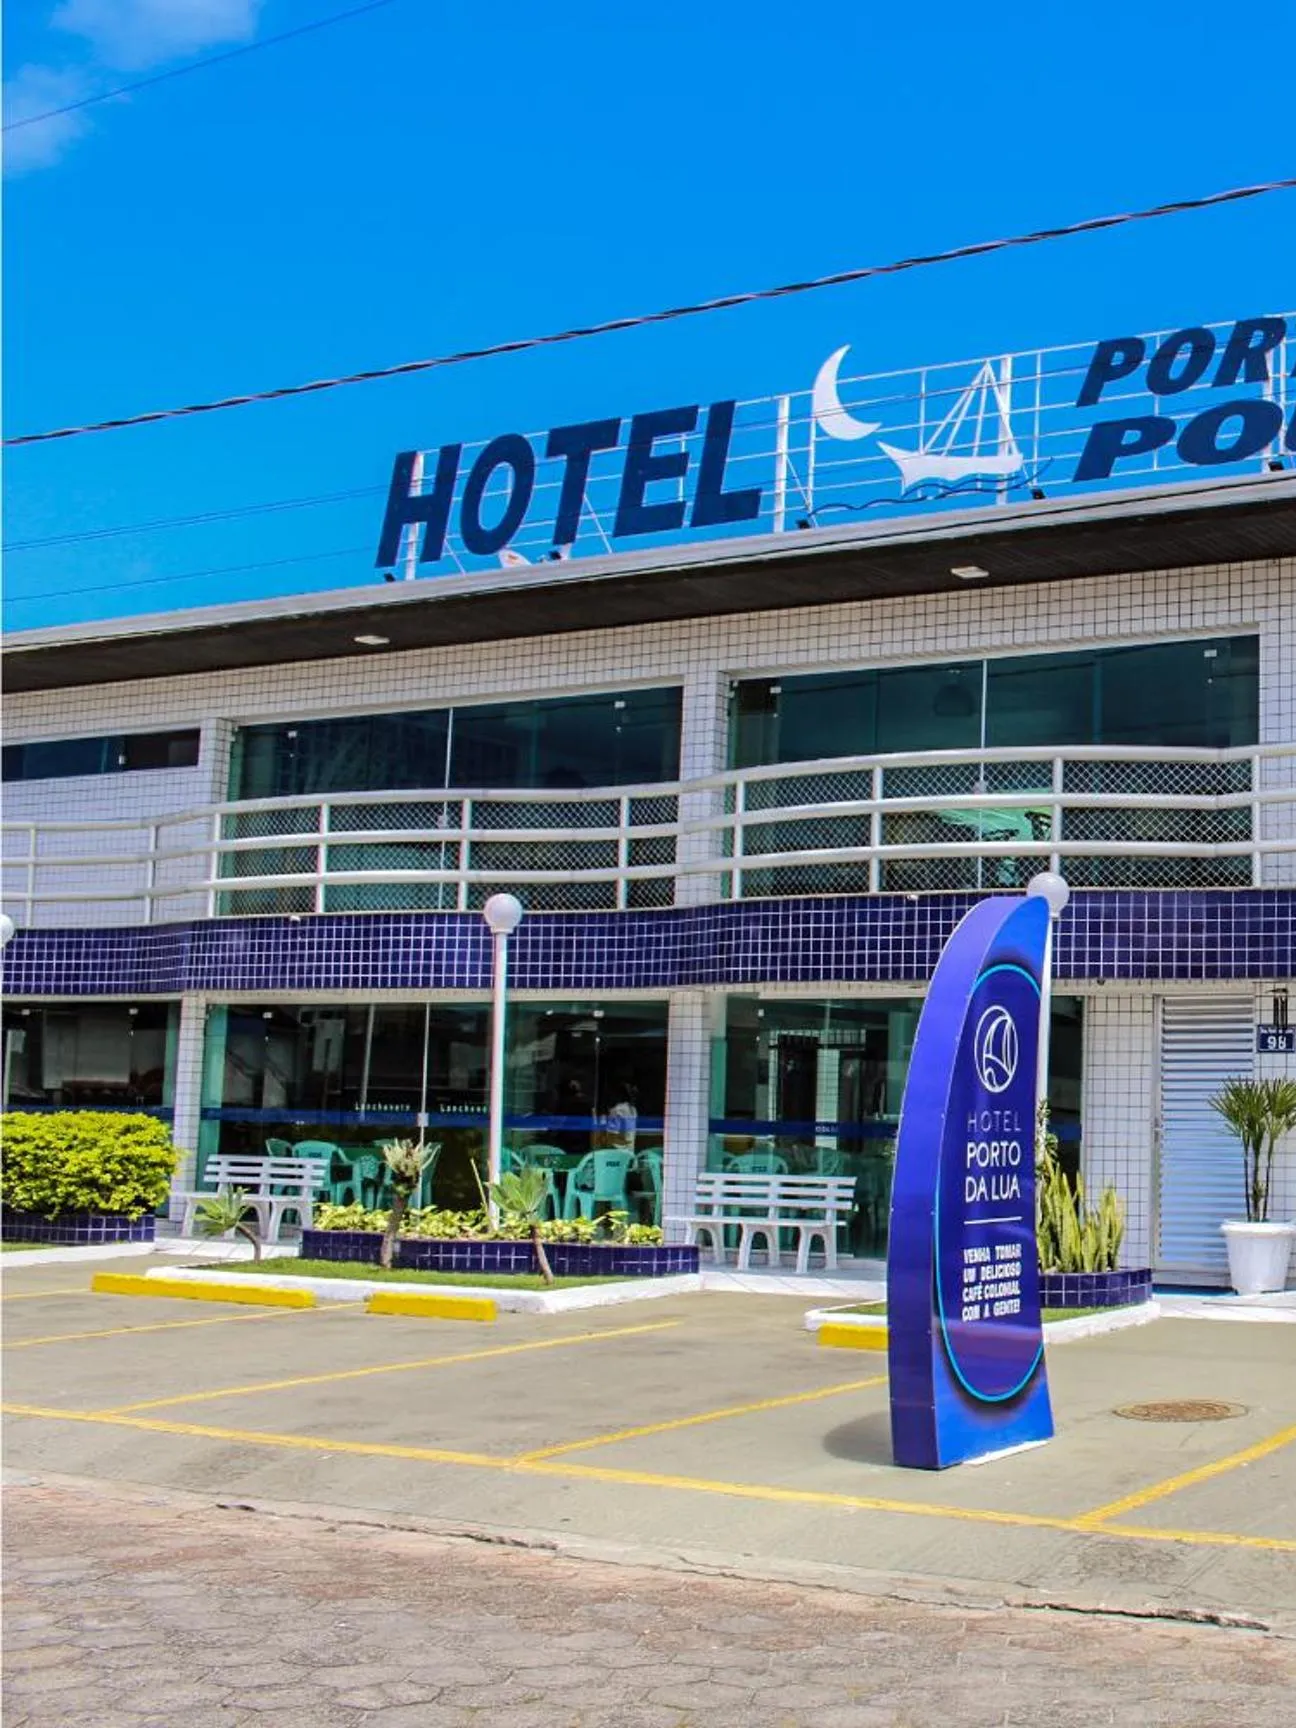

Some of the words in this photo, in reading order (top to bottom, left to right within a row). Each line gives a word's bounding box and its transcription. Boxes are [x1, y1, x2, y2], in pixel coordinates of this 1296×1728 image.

[374, 400, 761, 568] HOTEL
[967, 1110, 1021, 1132] HOTEL
[967, 1140, 1021, 1168] PORTO
[965, 1175, 989, 1203] DA
[991, 1173, 1021, 1200] LUA
